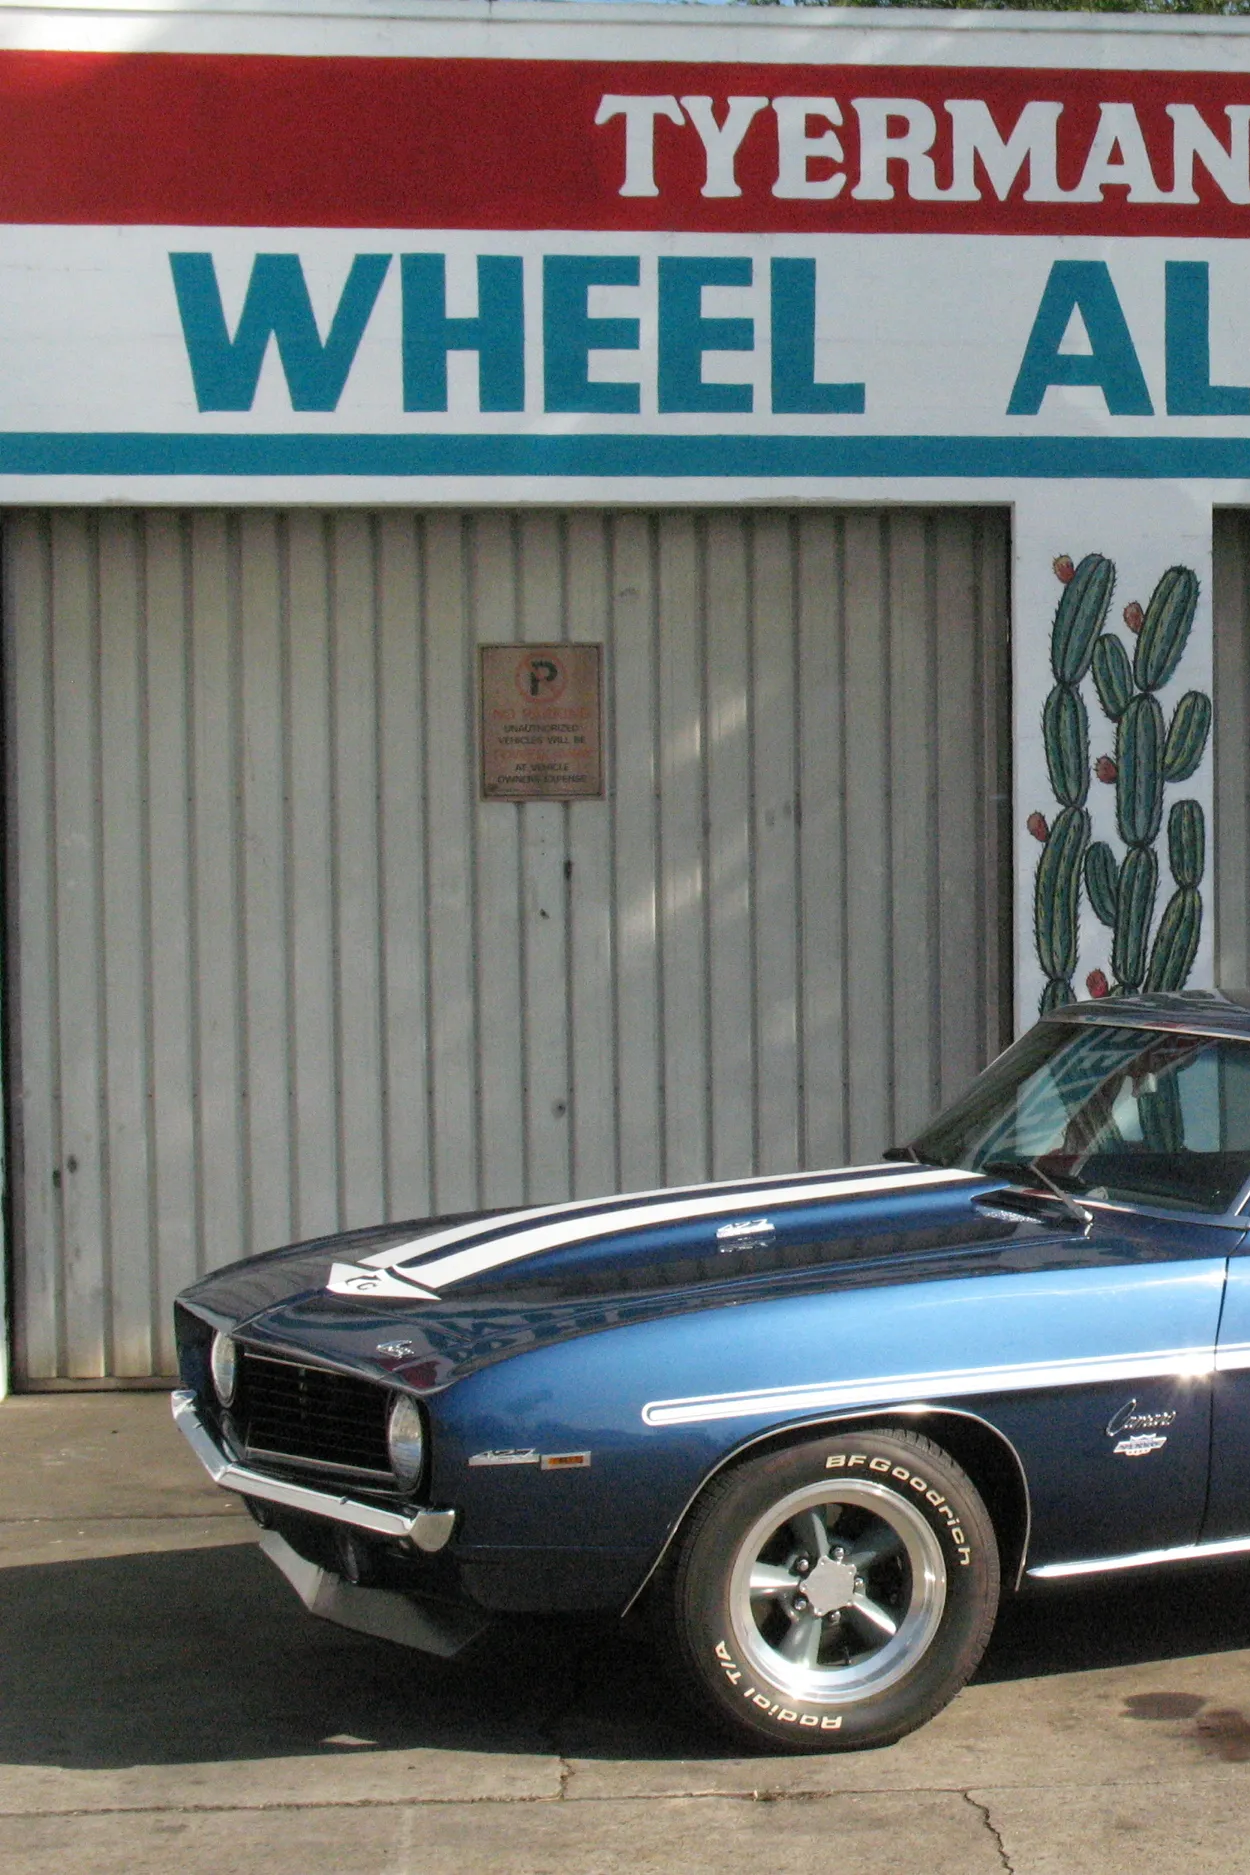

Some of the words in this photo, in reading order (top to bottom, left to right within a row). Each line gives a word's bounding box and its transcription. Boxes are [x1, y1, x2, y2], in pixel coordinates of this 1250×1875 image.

[167, 250, 867, 416] WHEEL
[497, 735, 544, 745] VEHICLES
[547, 735, 570, 744] WILL
[503, 723, 580, 733] UNAUTHORIZED
[825, 1454, 972, 1567] BFGoodrich
[714, 1639, 743, 1686] T/A
[743, 1687, 843, 1730] Radial
